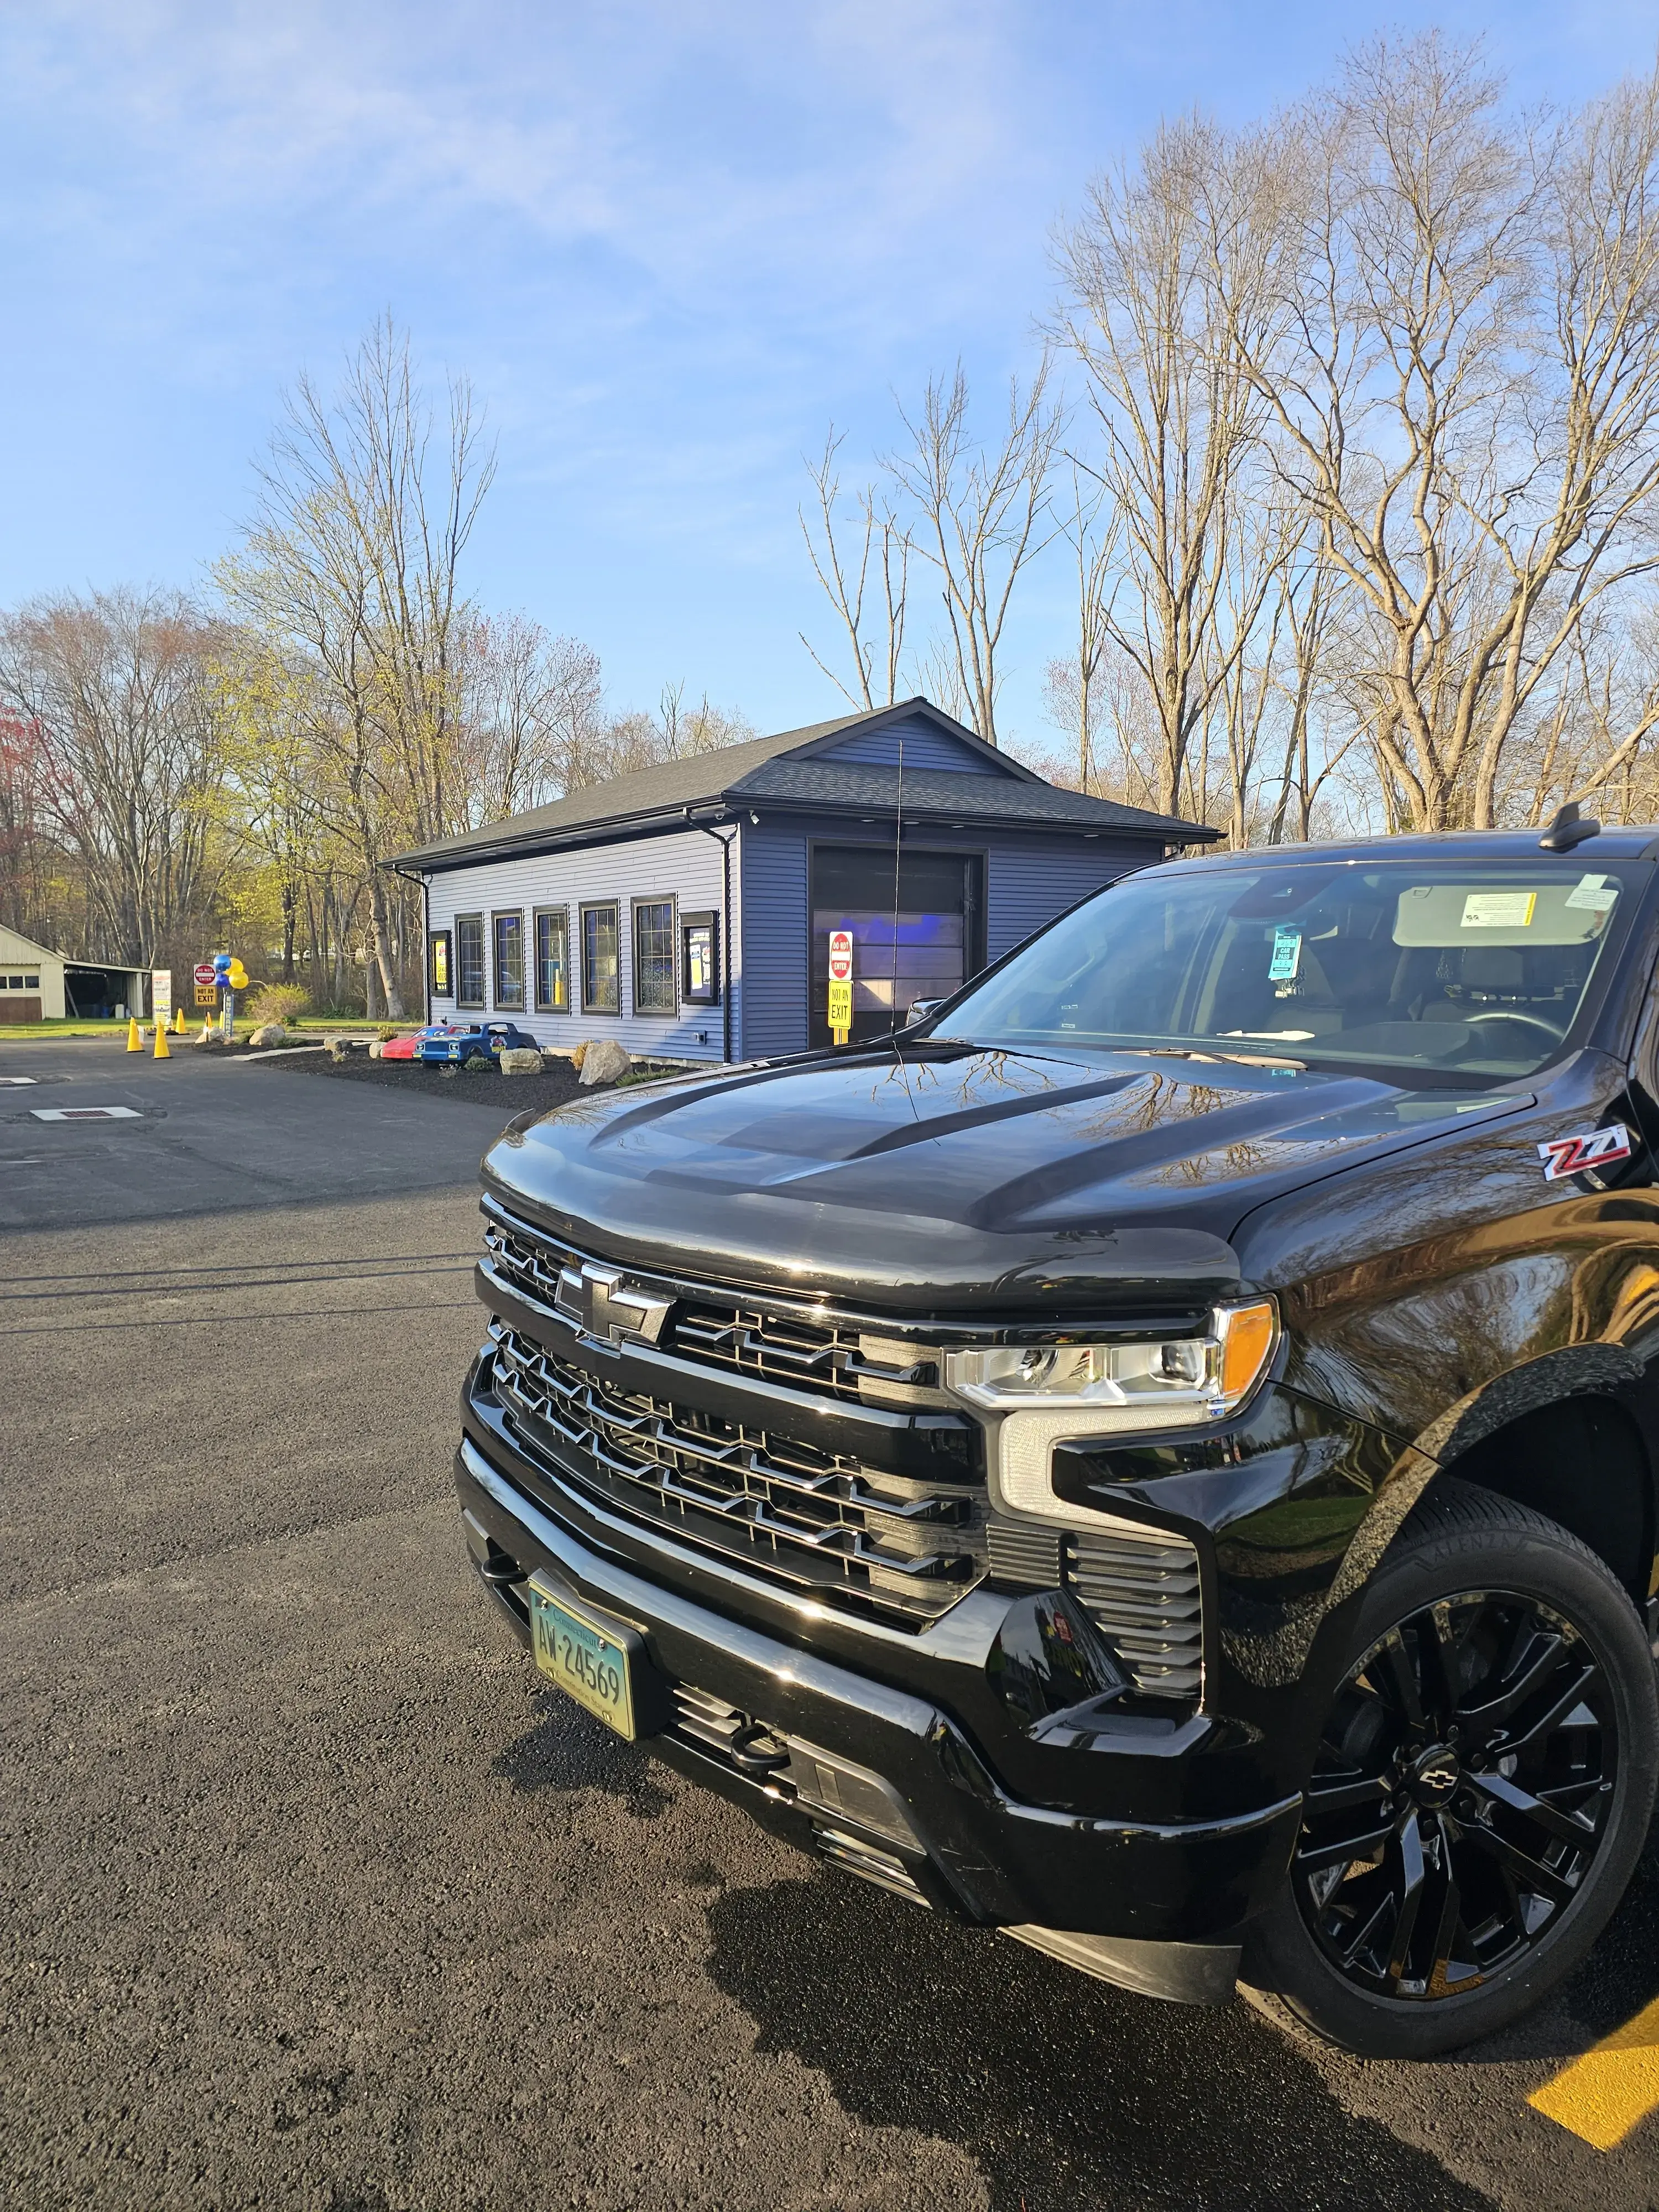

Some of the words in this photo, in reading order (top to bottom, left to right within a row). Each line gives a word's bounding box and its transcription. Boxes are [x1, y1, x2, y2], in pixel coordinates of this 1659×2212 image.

[833, 941, 839, 950] DO
[840, 941, 848, 950] NOT
[832, 989, 841, 1001] NOT
[842, 989, 848, 1001] AN
[832, 1004, 848, 1020] EXIT
[553, 1608, 597, 1648] Connecticut
[556, 1670, 589, 1702] Constitution
